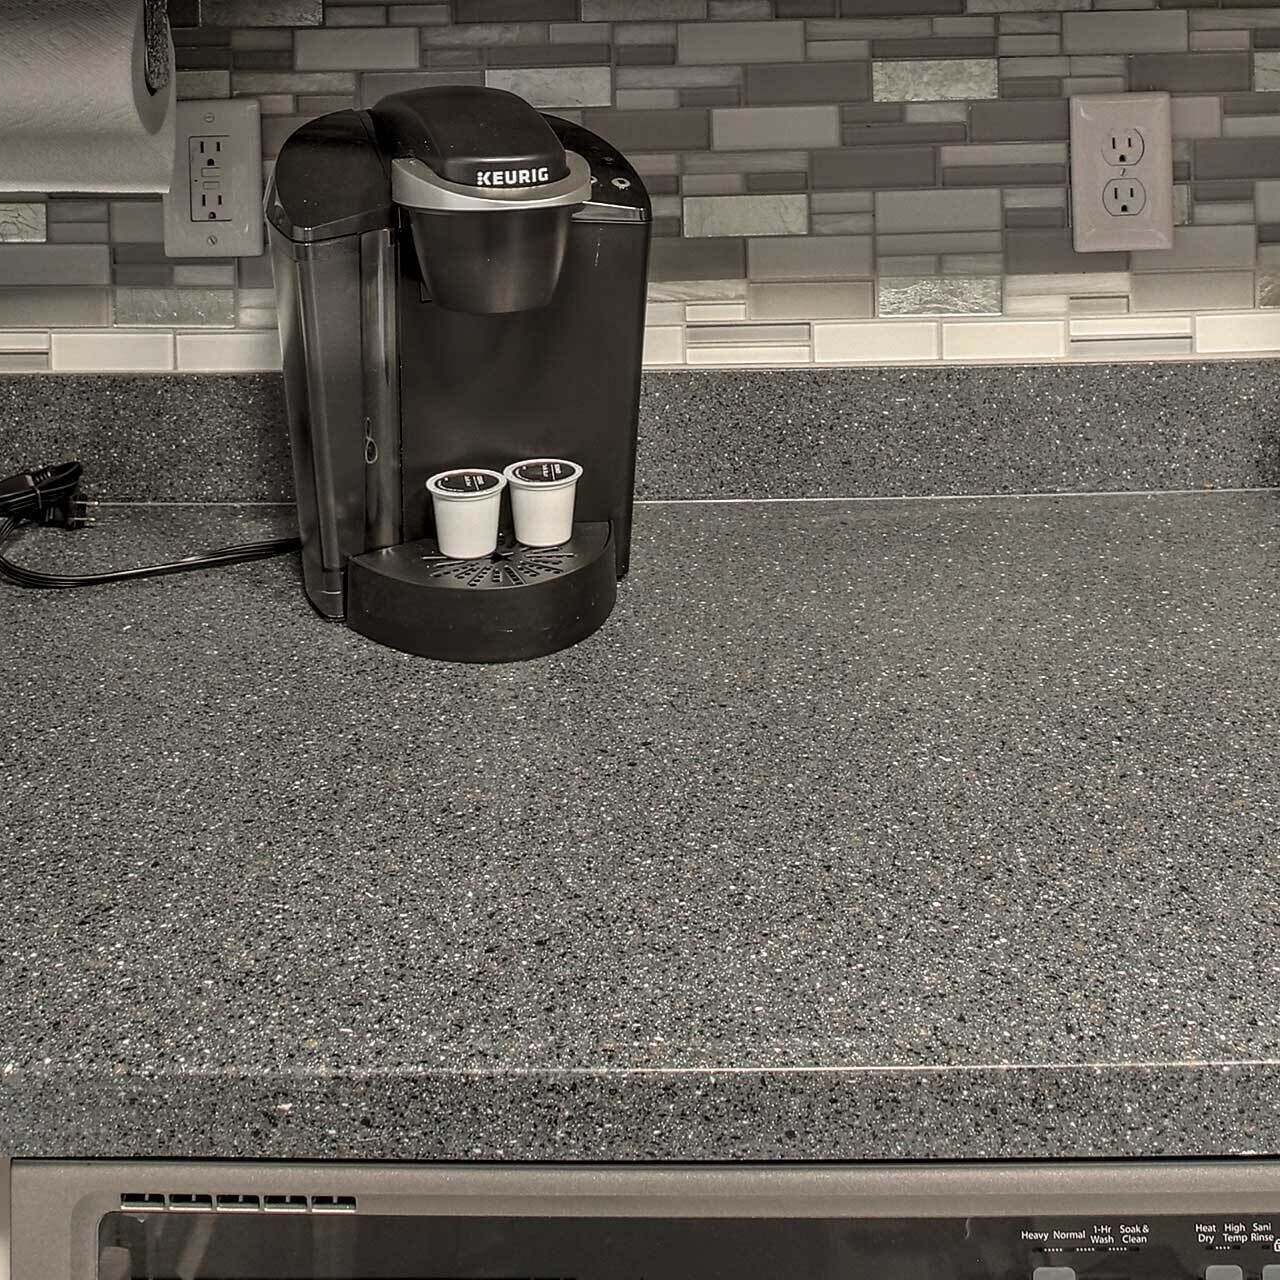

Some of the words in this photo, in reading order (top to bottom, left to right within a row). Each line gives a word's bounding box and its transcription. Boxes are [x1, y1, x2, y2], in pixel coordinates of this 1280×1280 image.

[477, 167, 549, 186] KEURIG
[1093, 1225, 1112, 1234] 1-Hr
[1120, 1224, 1141, 1234] Soak
[1142, 1224, 1150, 1233] &
[1195, 1223, 1216, 1233] Heat
[1224, 1223, 1246, 1234] High
[1252, 1222, 1272, 1232] Sani
[1021, 1230, 1049, 1241] Heavy
[1053, 1230, 1086, 1239] Normal
[1090, 1234, 1115, 1244] Wash
[1121, 1234, 1148, 1244] Clean
[1198, 1233, 1215, 1244] Dry
[1222, 1233, 1248, 1244] Temp
[1250, 1232, 1275, 1242] Rinse
